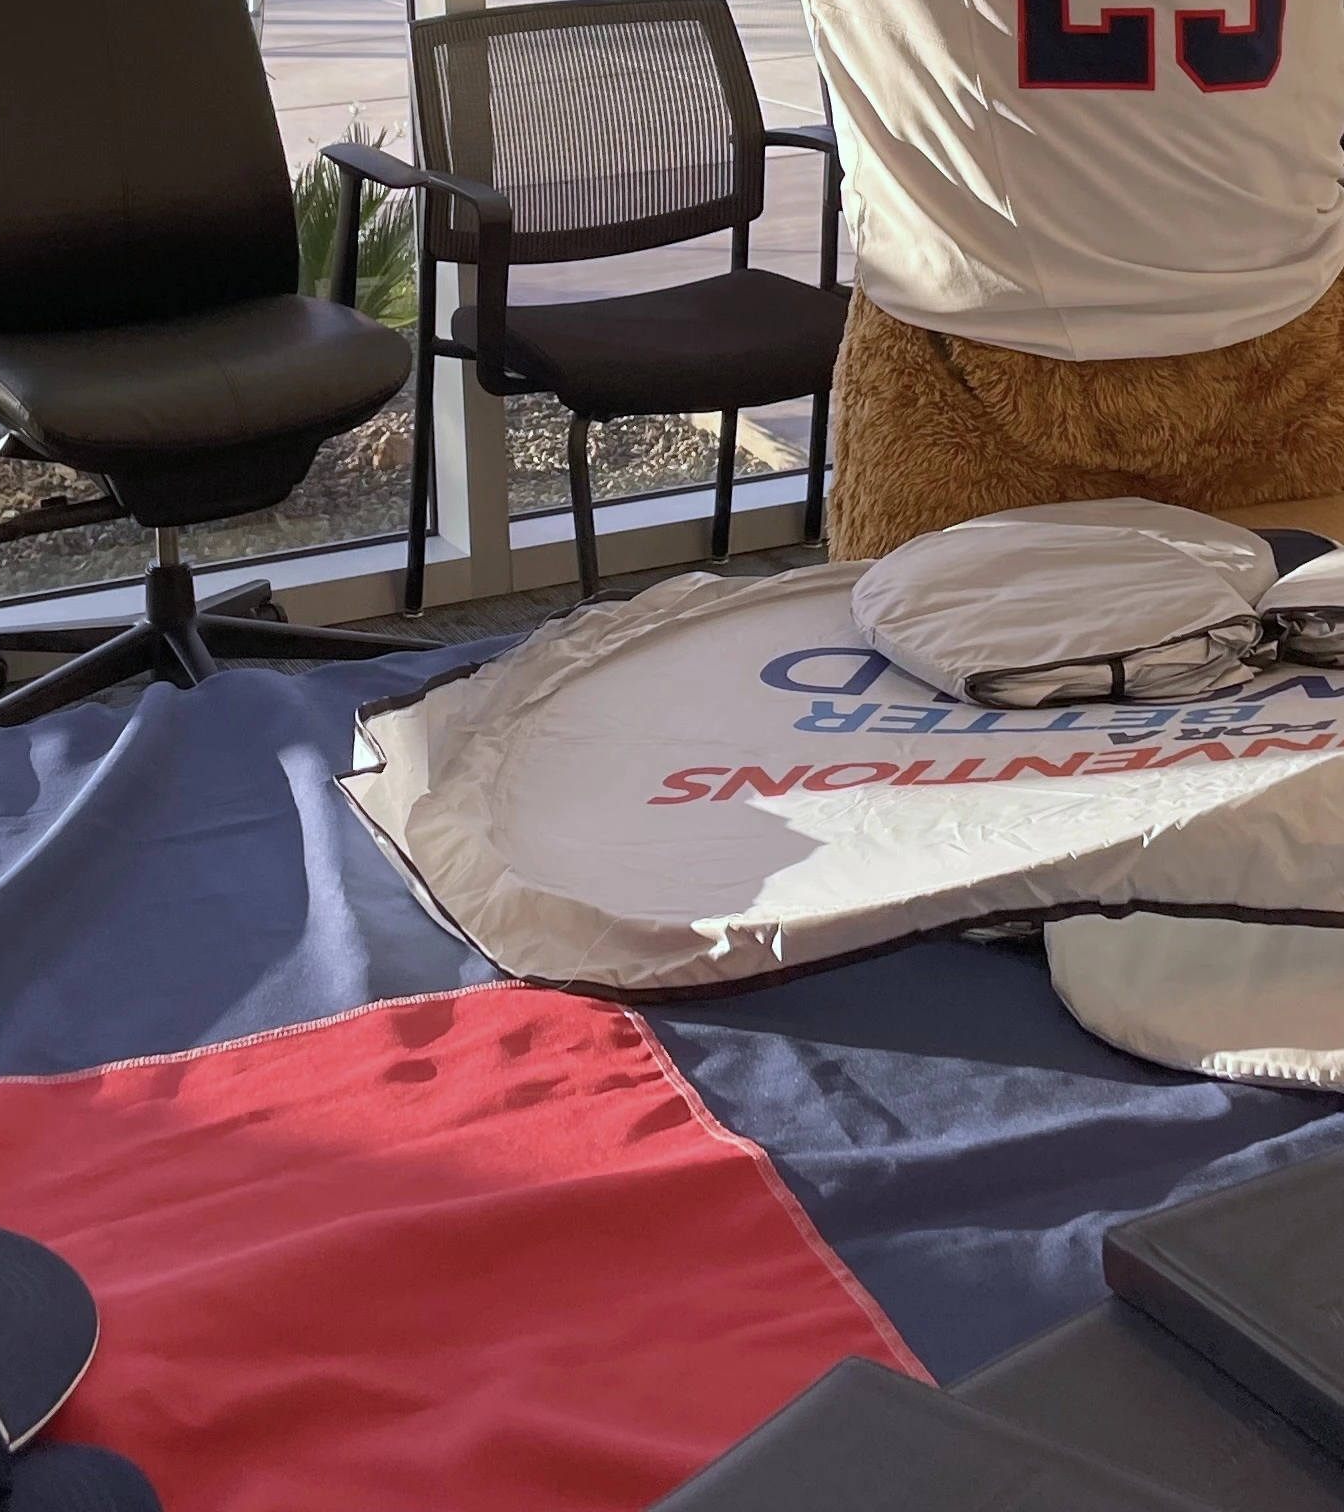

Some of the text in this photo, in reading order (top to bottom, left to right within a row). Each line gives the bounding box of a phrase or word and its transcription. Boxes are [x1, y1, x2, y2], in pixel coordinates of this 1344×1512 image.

[792, 701, 1266, 735] BETTER
[1107, 718, 1337, 746] FOR A
